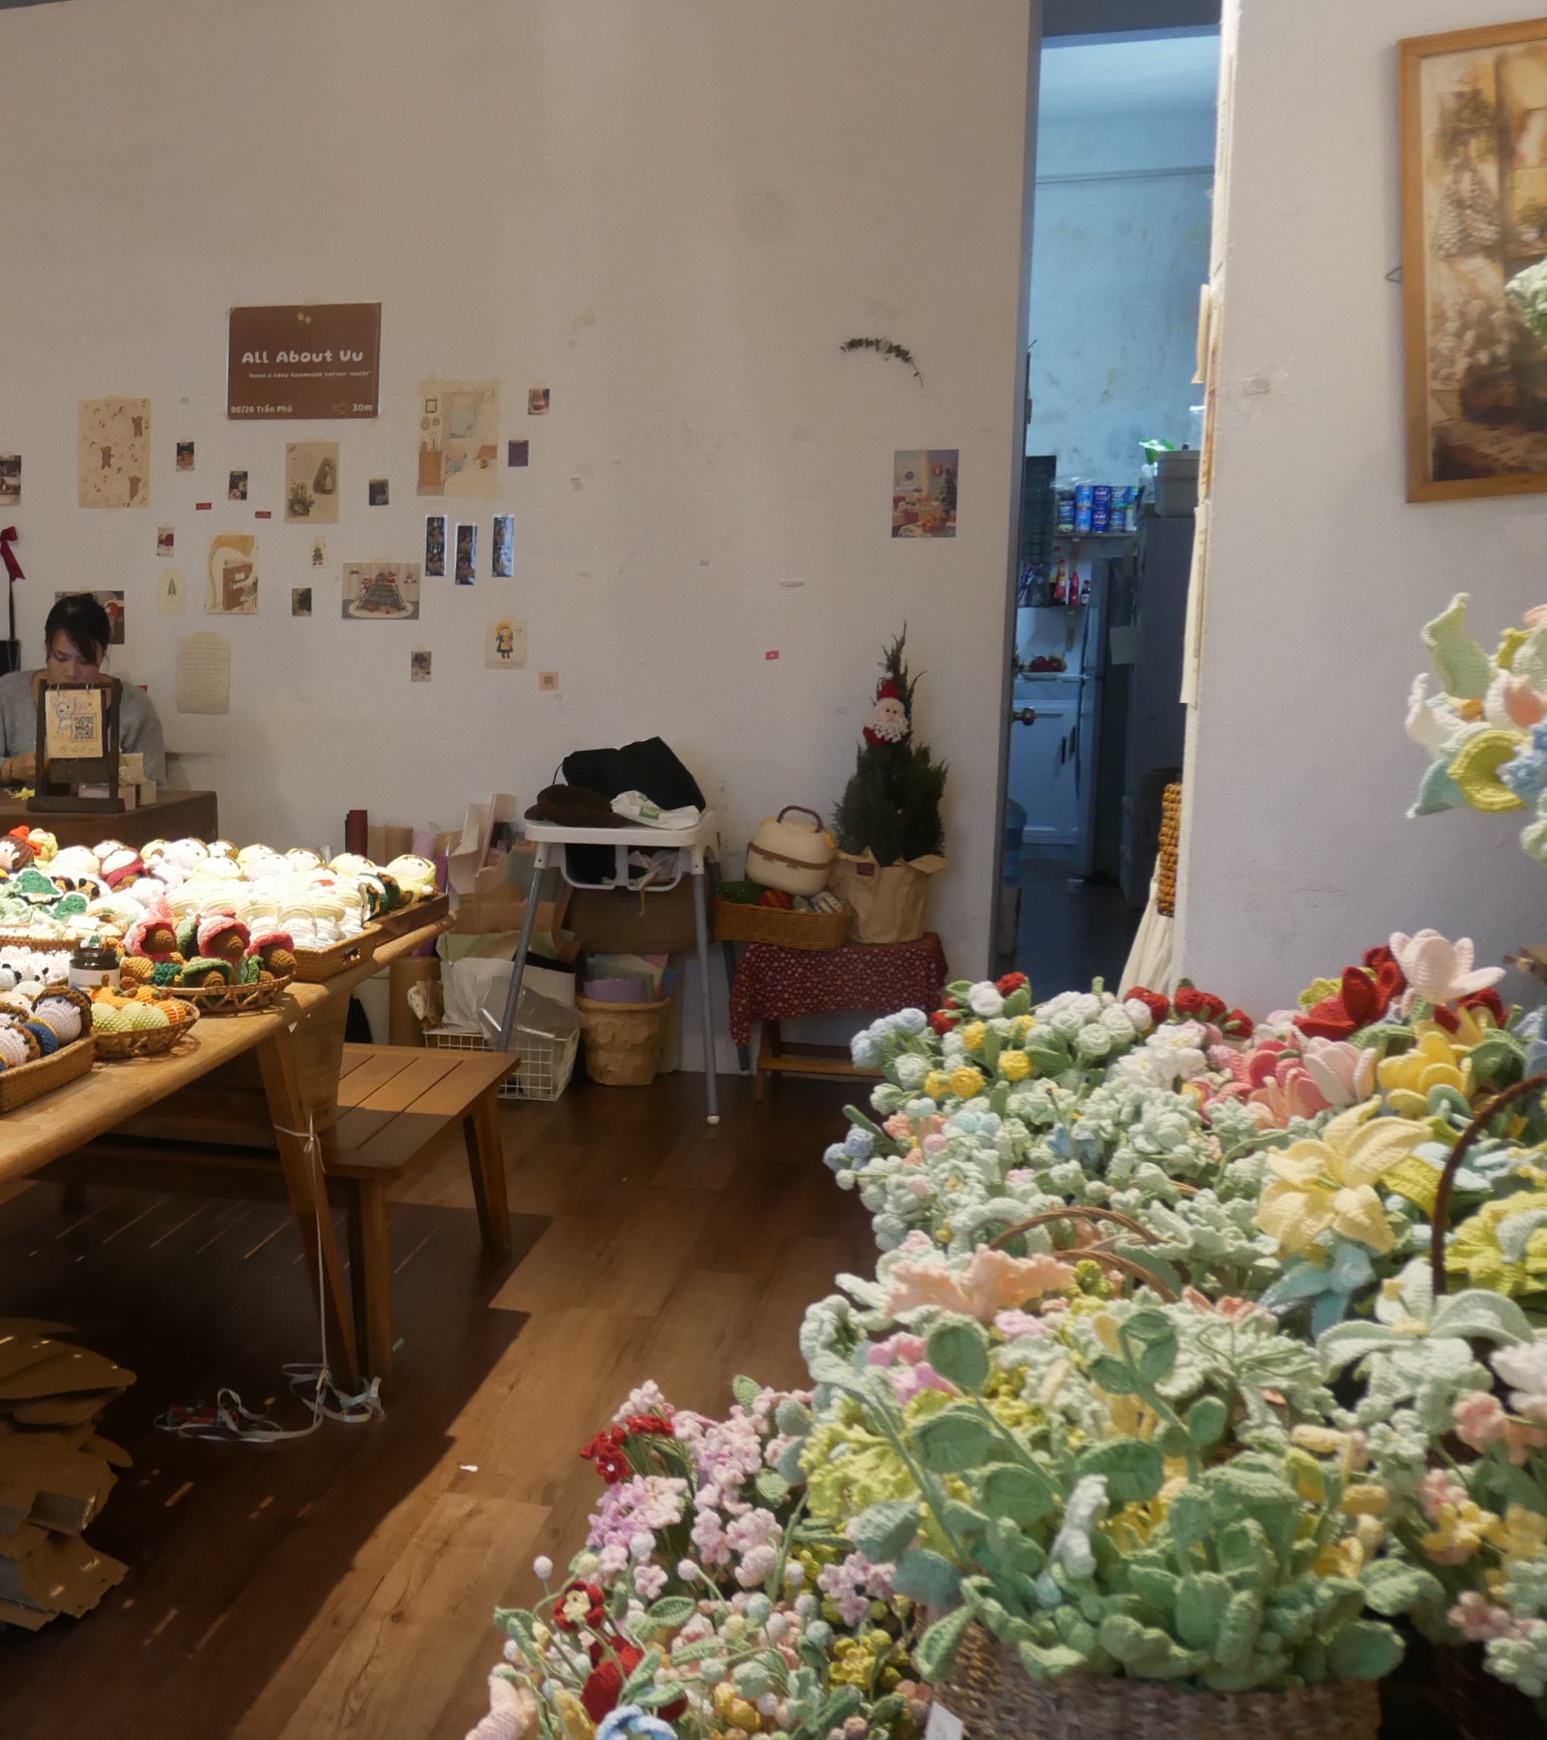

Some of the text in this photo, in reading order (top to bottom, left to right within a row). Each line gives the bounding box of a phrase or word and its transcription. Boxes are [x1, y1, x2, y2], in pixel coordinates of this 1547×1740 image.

[242, 351, 269, 364] All
[276, 350, 332, 363] About
[353, 403, 372, 412] 30m
